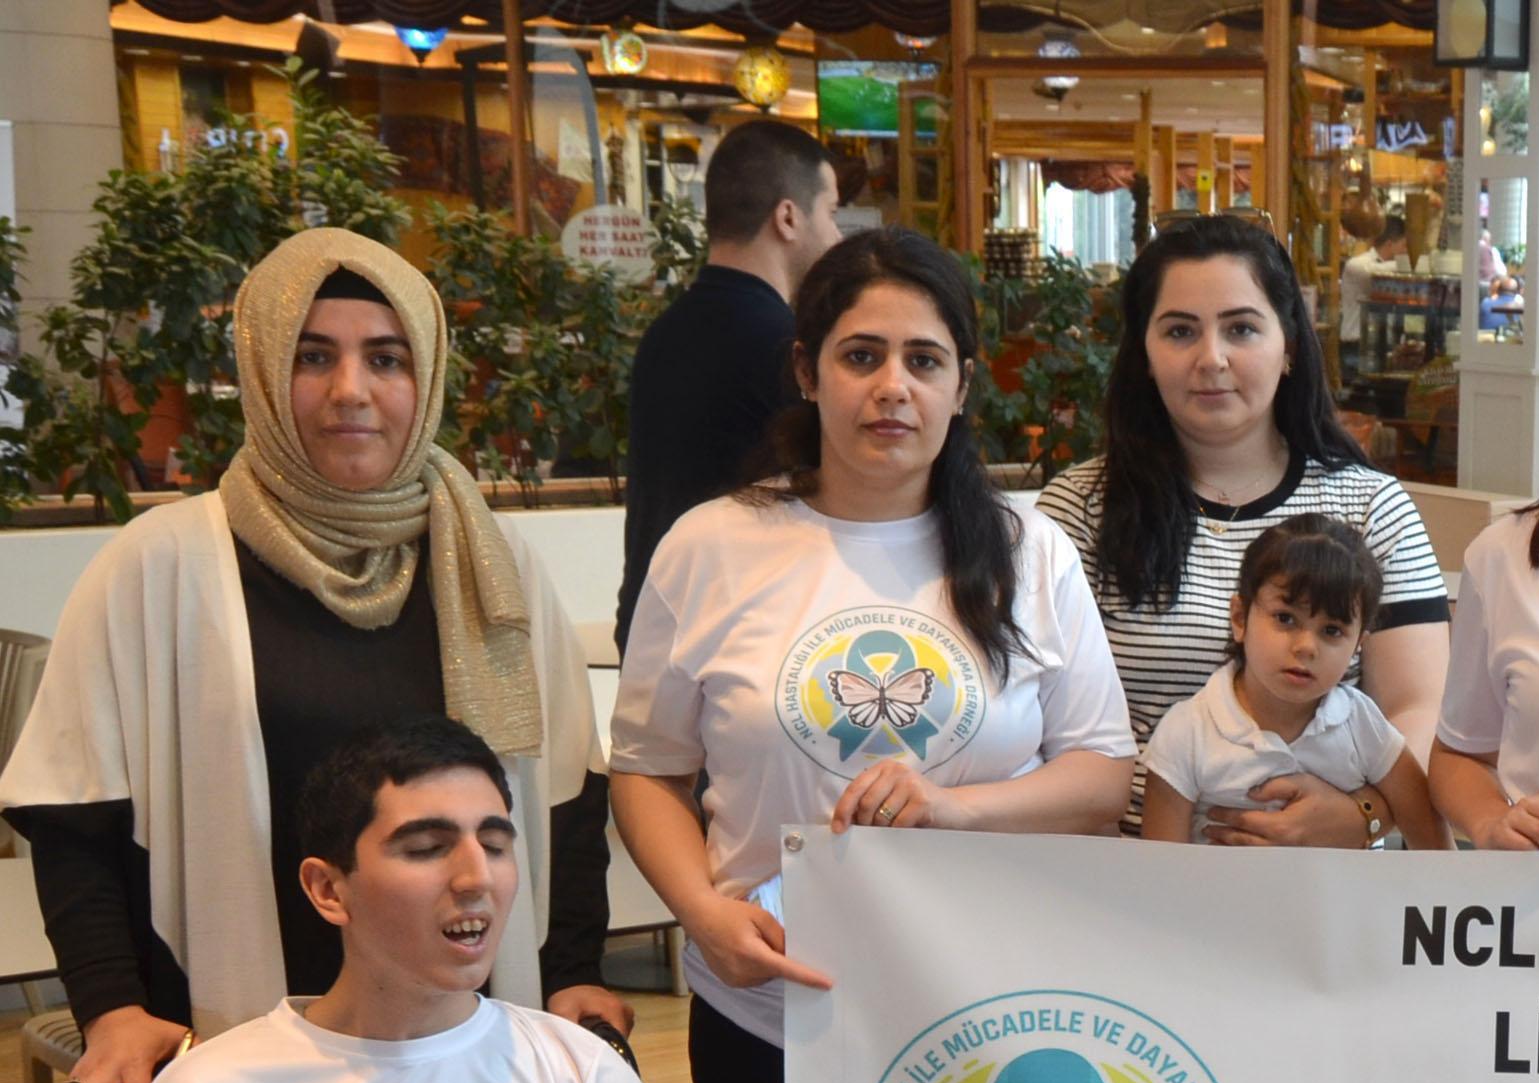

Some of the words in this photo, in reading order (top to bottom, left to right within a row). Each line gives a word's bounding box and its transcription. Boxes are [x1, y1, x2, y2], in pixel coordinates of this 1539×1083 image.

[792, 714, 813, 740] NCL
[824, 613, 896, 636] MÜCADELE
[900, 616, 916, 629] VE
[1403, 906, 1535, 967] NCL
[942, 1009, 1084, 1060] MÜCADELE
[1092, 1015, 1126, 1045] VE
